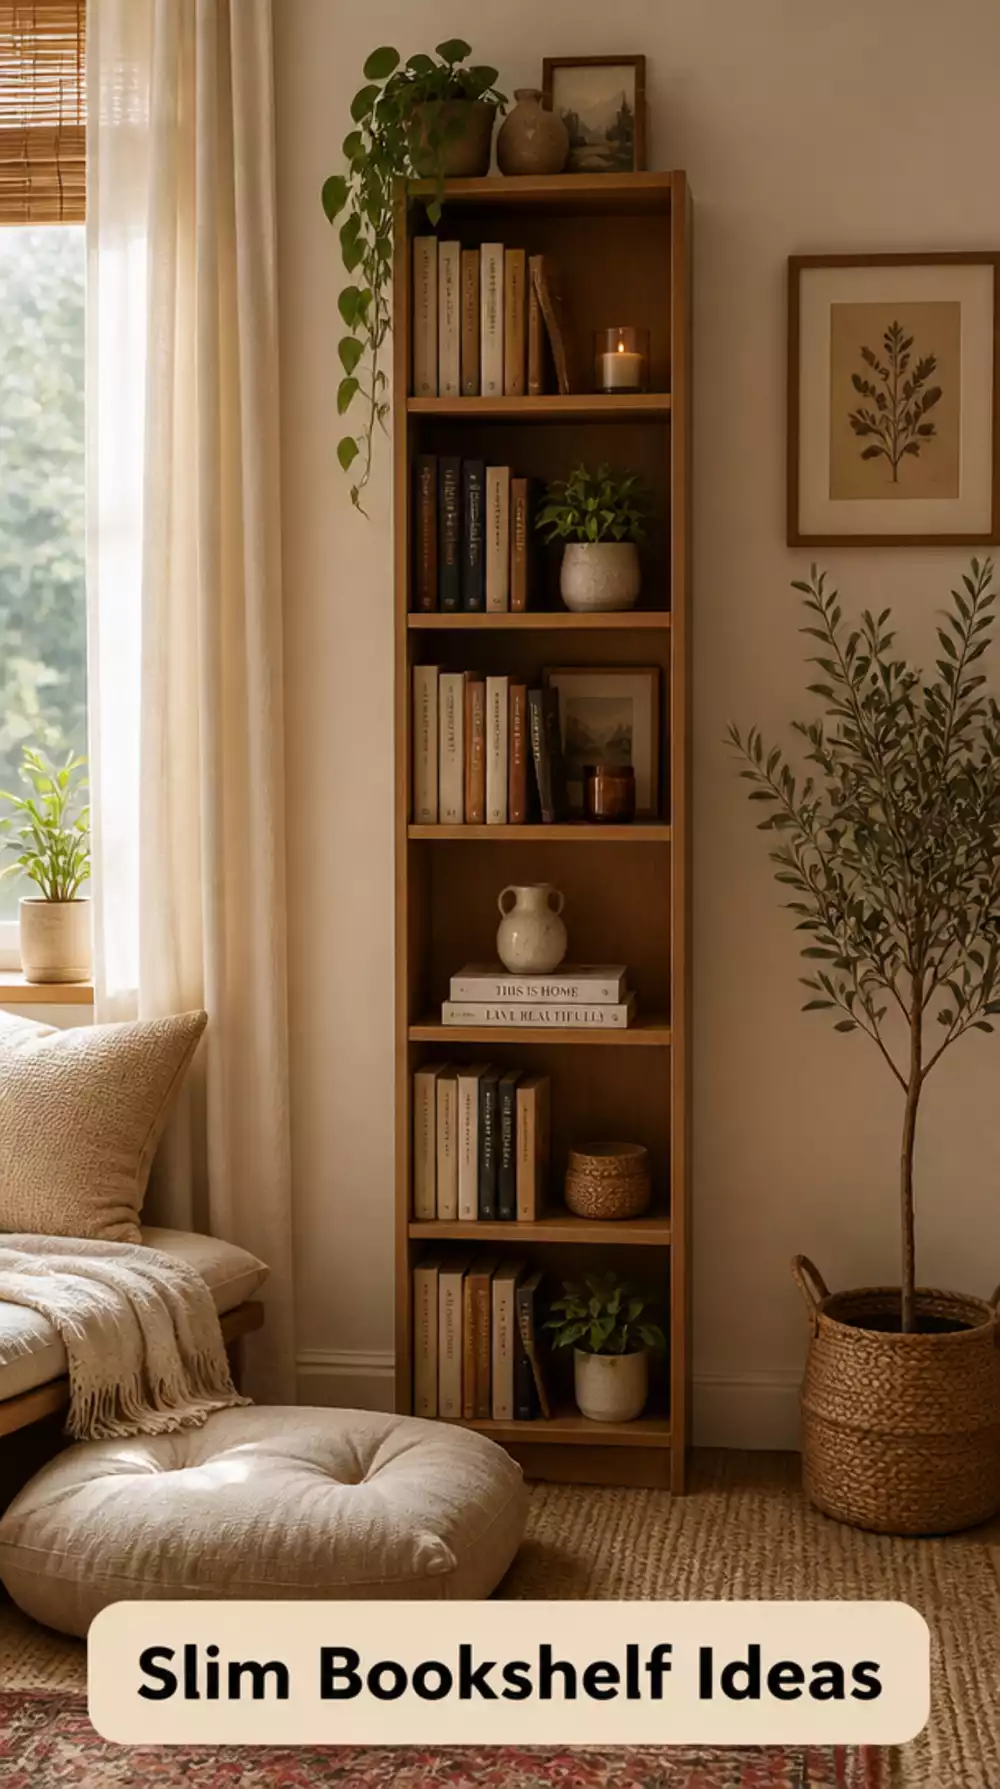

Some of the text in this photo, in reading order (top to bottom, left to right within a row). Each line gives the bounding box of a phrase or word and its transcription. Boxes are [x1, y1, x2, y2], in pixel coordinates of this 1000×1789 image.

[496, 985, 579, 998] THIS IS HOME
